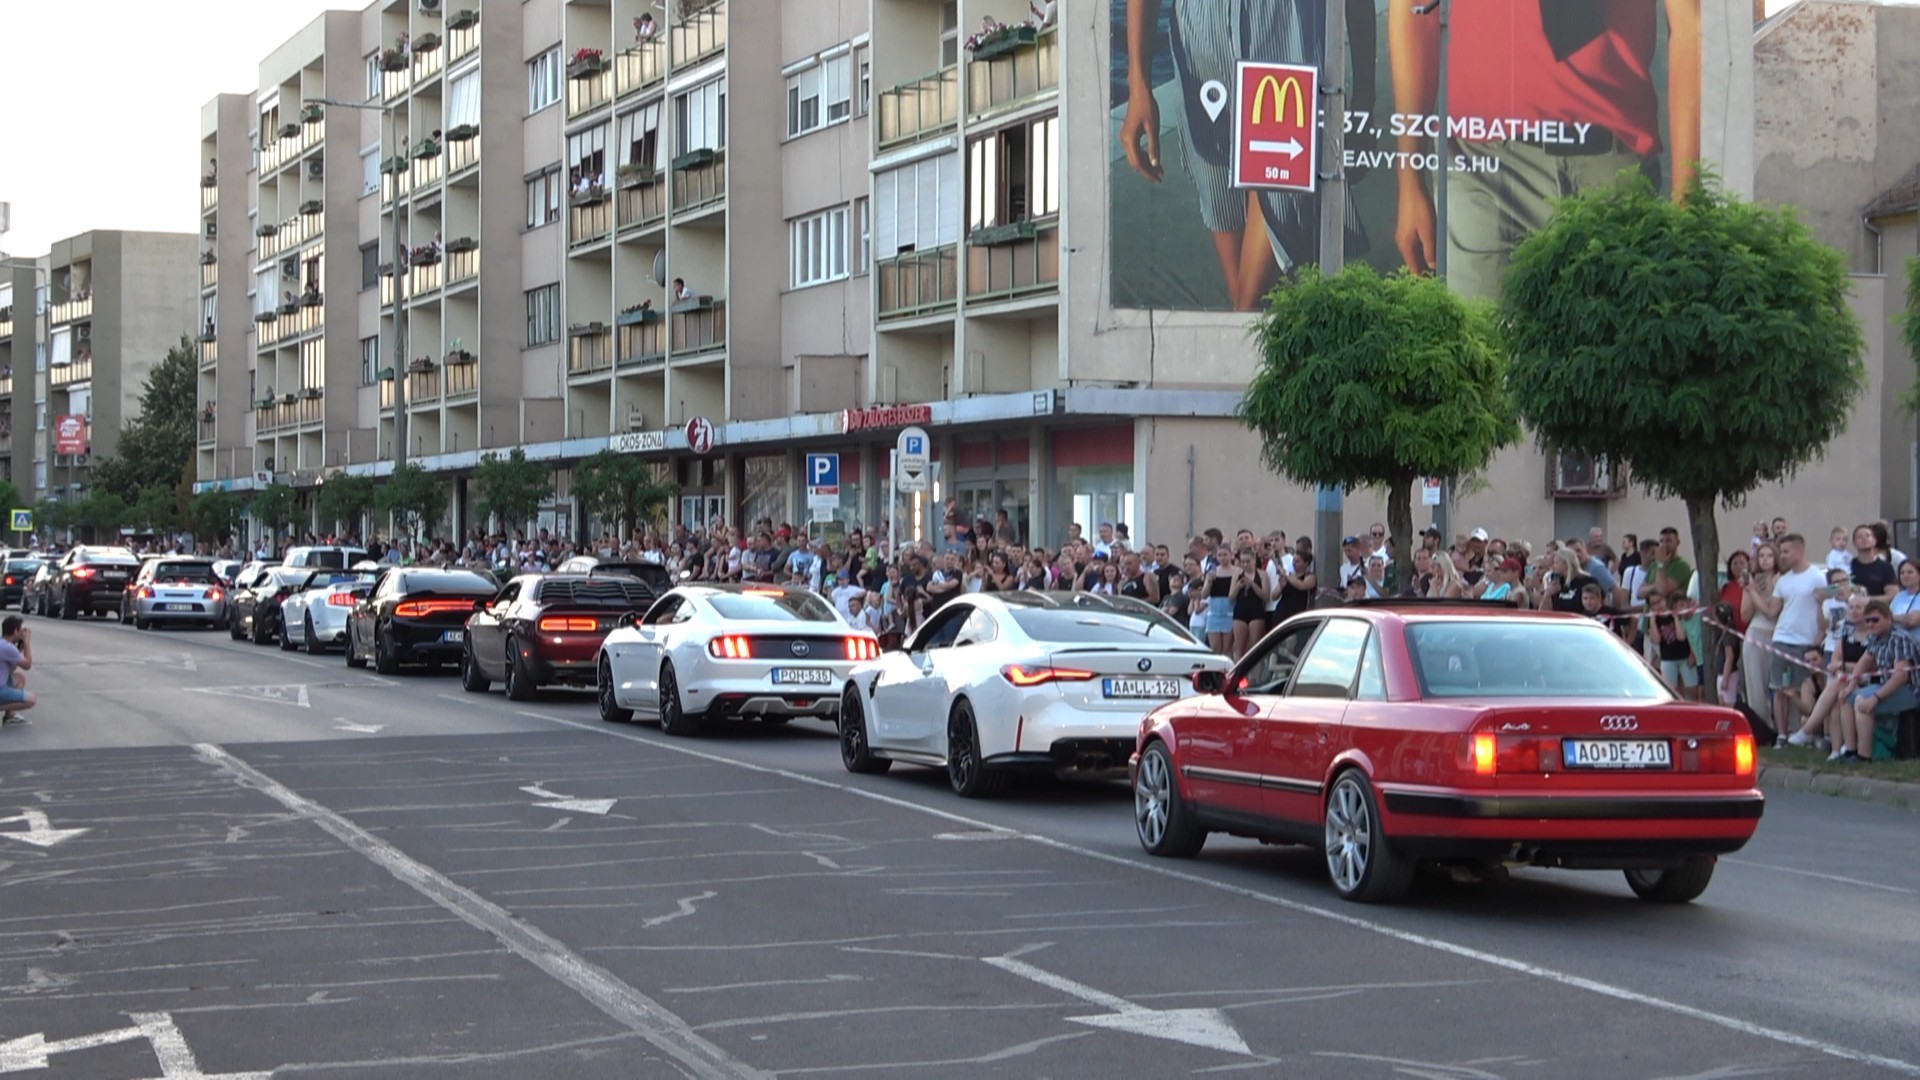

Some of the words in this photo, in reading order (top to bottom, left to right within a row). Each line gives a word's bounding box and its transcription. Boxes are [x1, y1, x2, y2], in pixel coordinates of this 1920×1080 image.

[1389, 112, 1592, 145] SZOMBATHELY
[1265, 166, 1279, 180] 50
[1280, 168, 1290, 180] m
[1343, 149, 1500, 173] EAVYTOOS.HU
[909, 439, 919, 452] P
[815, 457, 831, 484] P
